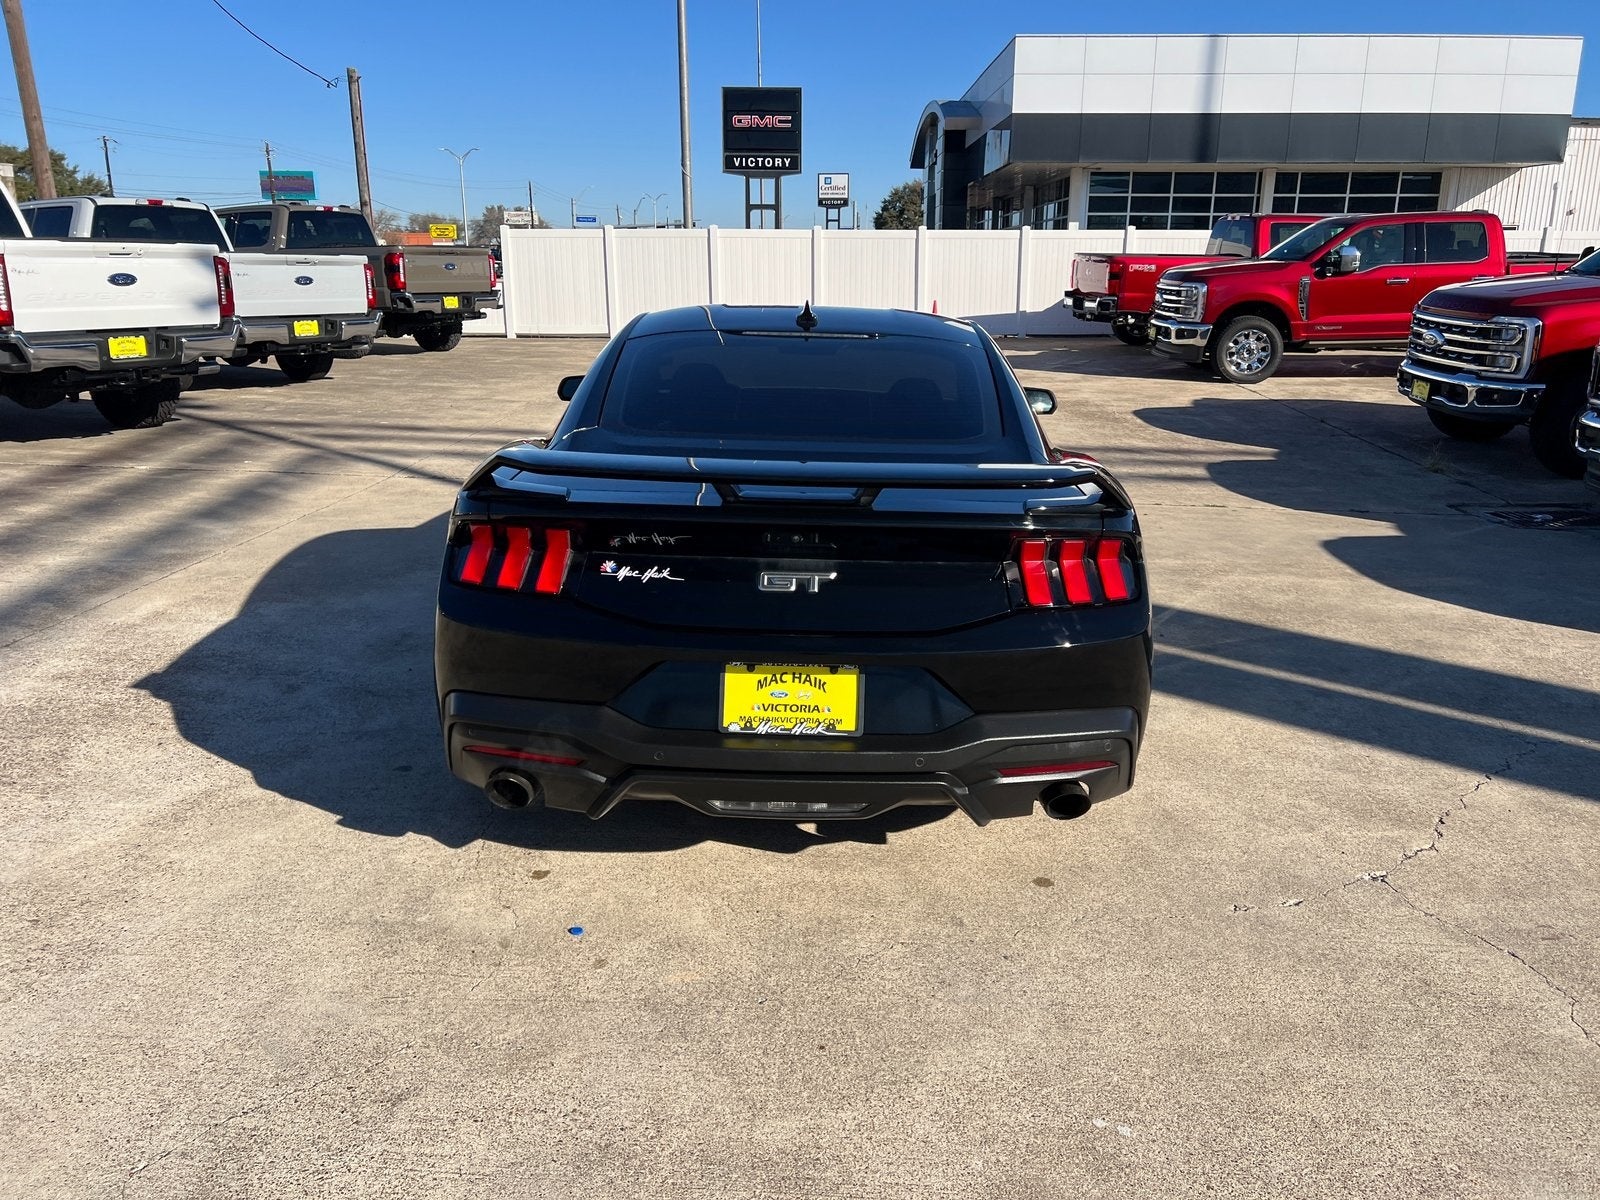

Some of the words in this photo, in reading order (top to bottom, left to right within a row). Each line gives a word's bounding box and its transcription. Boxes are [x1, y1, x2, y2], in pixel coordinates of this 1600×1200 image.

[732, 114, 792, 128] GMC
[733, 157, 791, 167] VICTORY
[616, 565, 642, 582] Mac
[641, 565, 680, 584] Haik
[758, 571, 838, 593] GT
[757, 672, 788, 691] MAC
[792, 672, 827, 693] HAIK
[762, 703, 821, 713] VICTORIA
[754, 720, 790, 735] Mac
[791, 721, 836, 735] Haik
